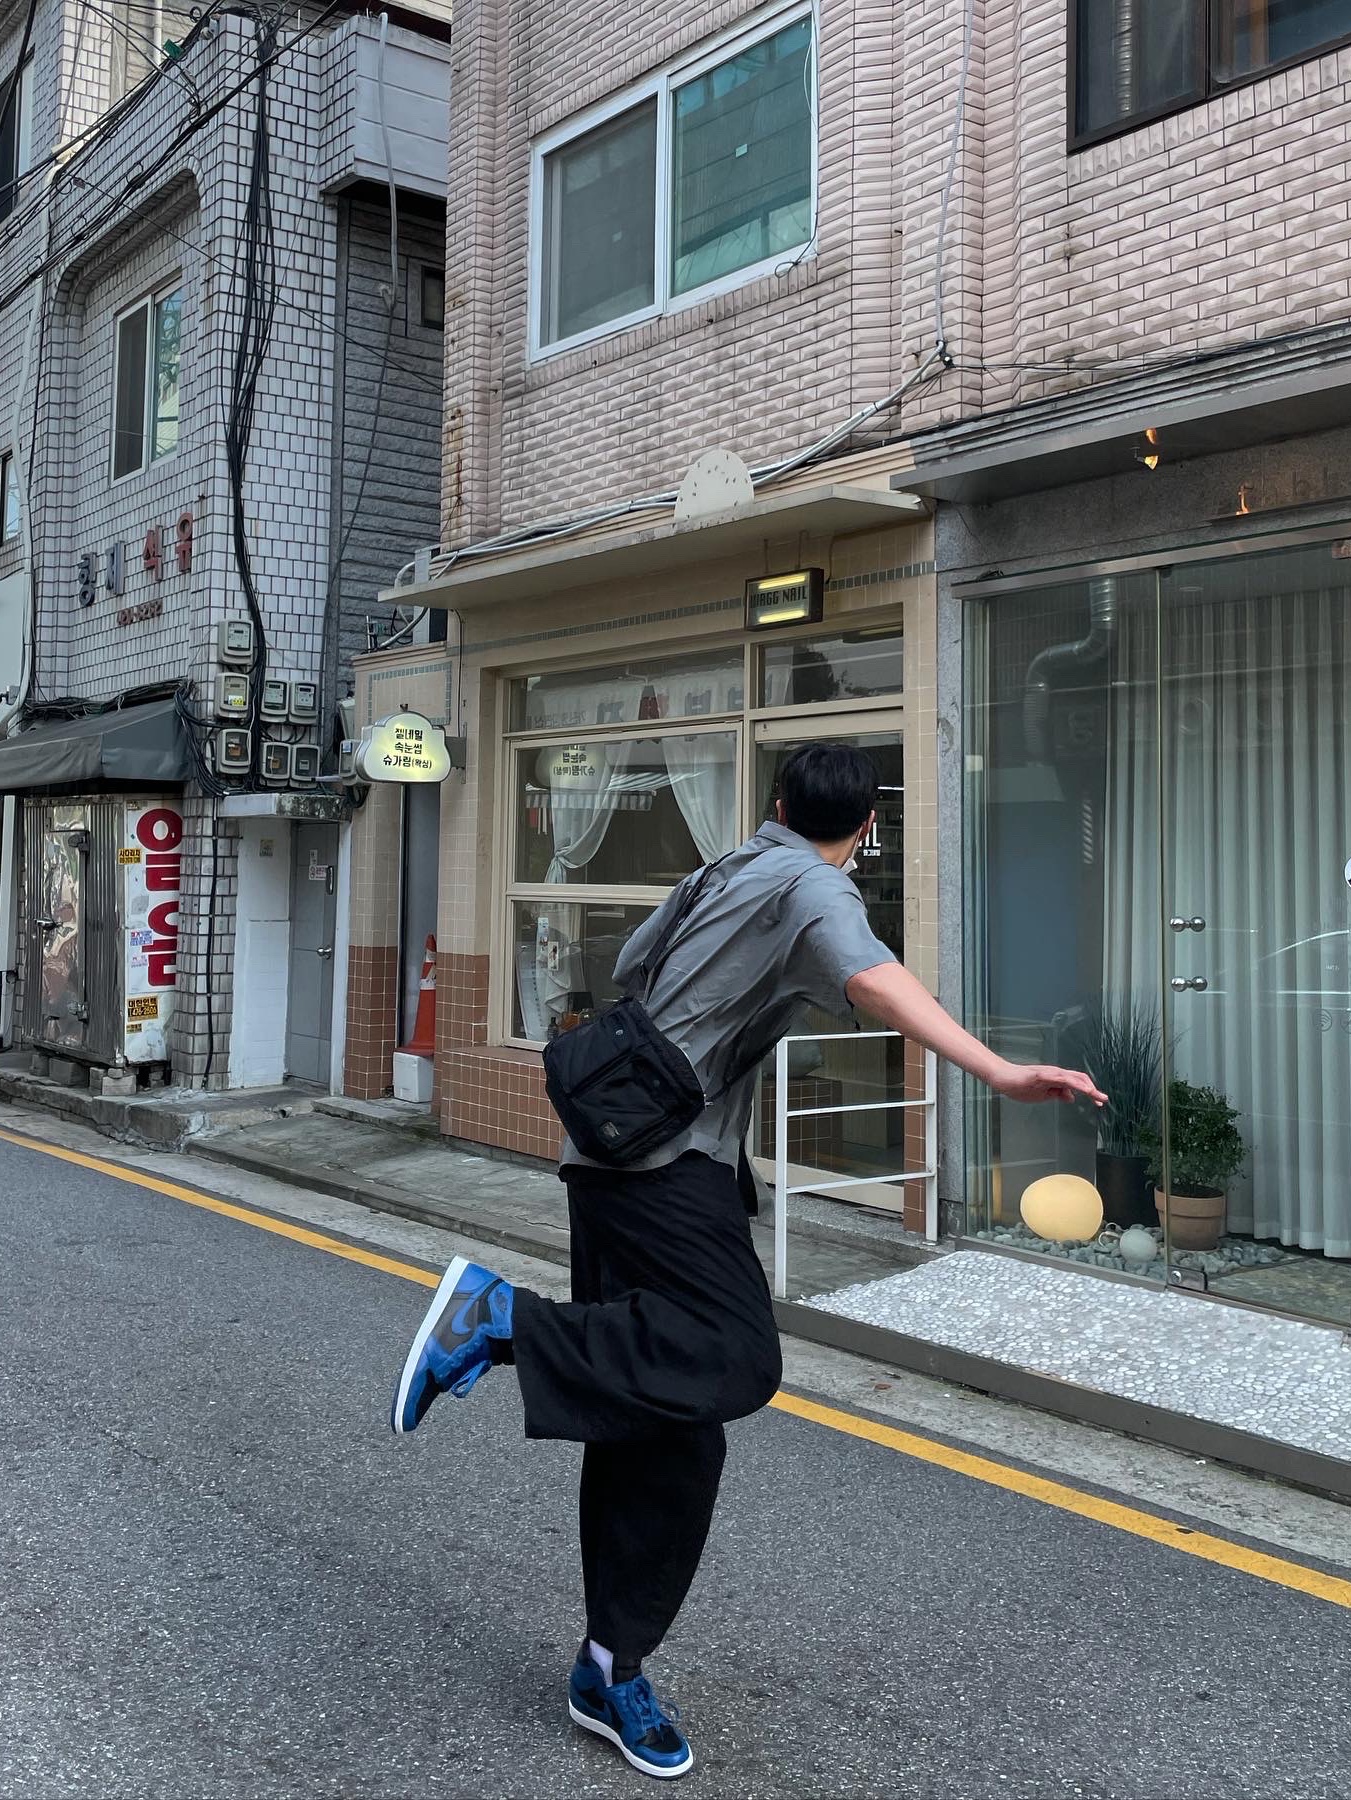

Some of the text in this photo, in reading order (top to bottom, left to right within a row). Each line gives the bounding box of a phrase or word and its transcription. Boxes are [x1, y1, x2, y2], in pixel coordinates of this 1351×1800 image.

[782, 585, 807, 604] NAIL
[394, 727, 424, 742] 젤네일
[394, 741, 423, 755] 속눈썹
